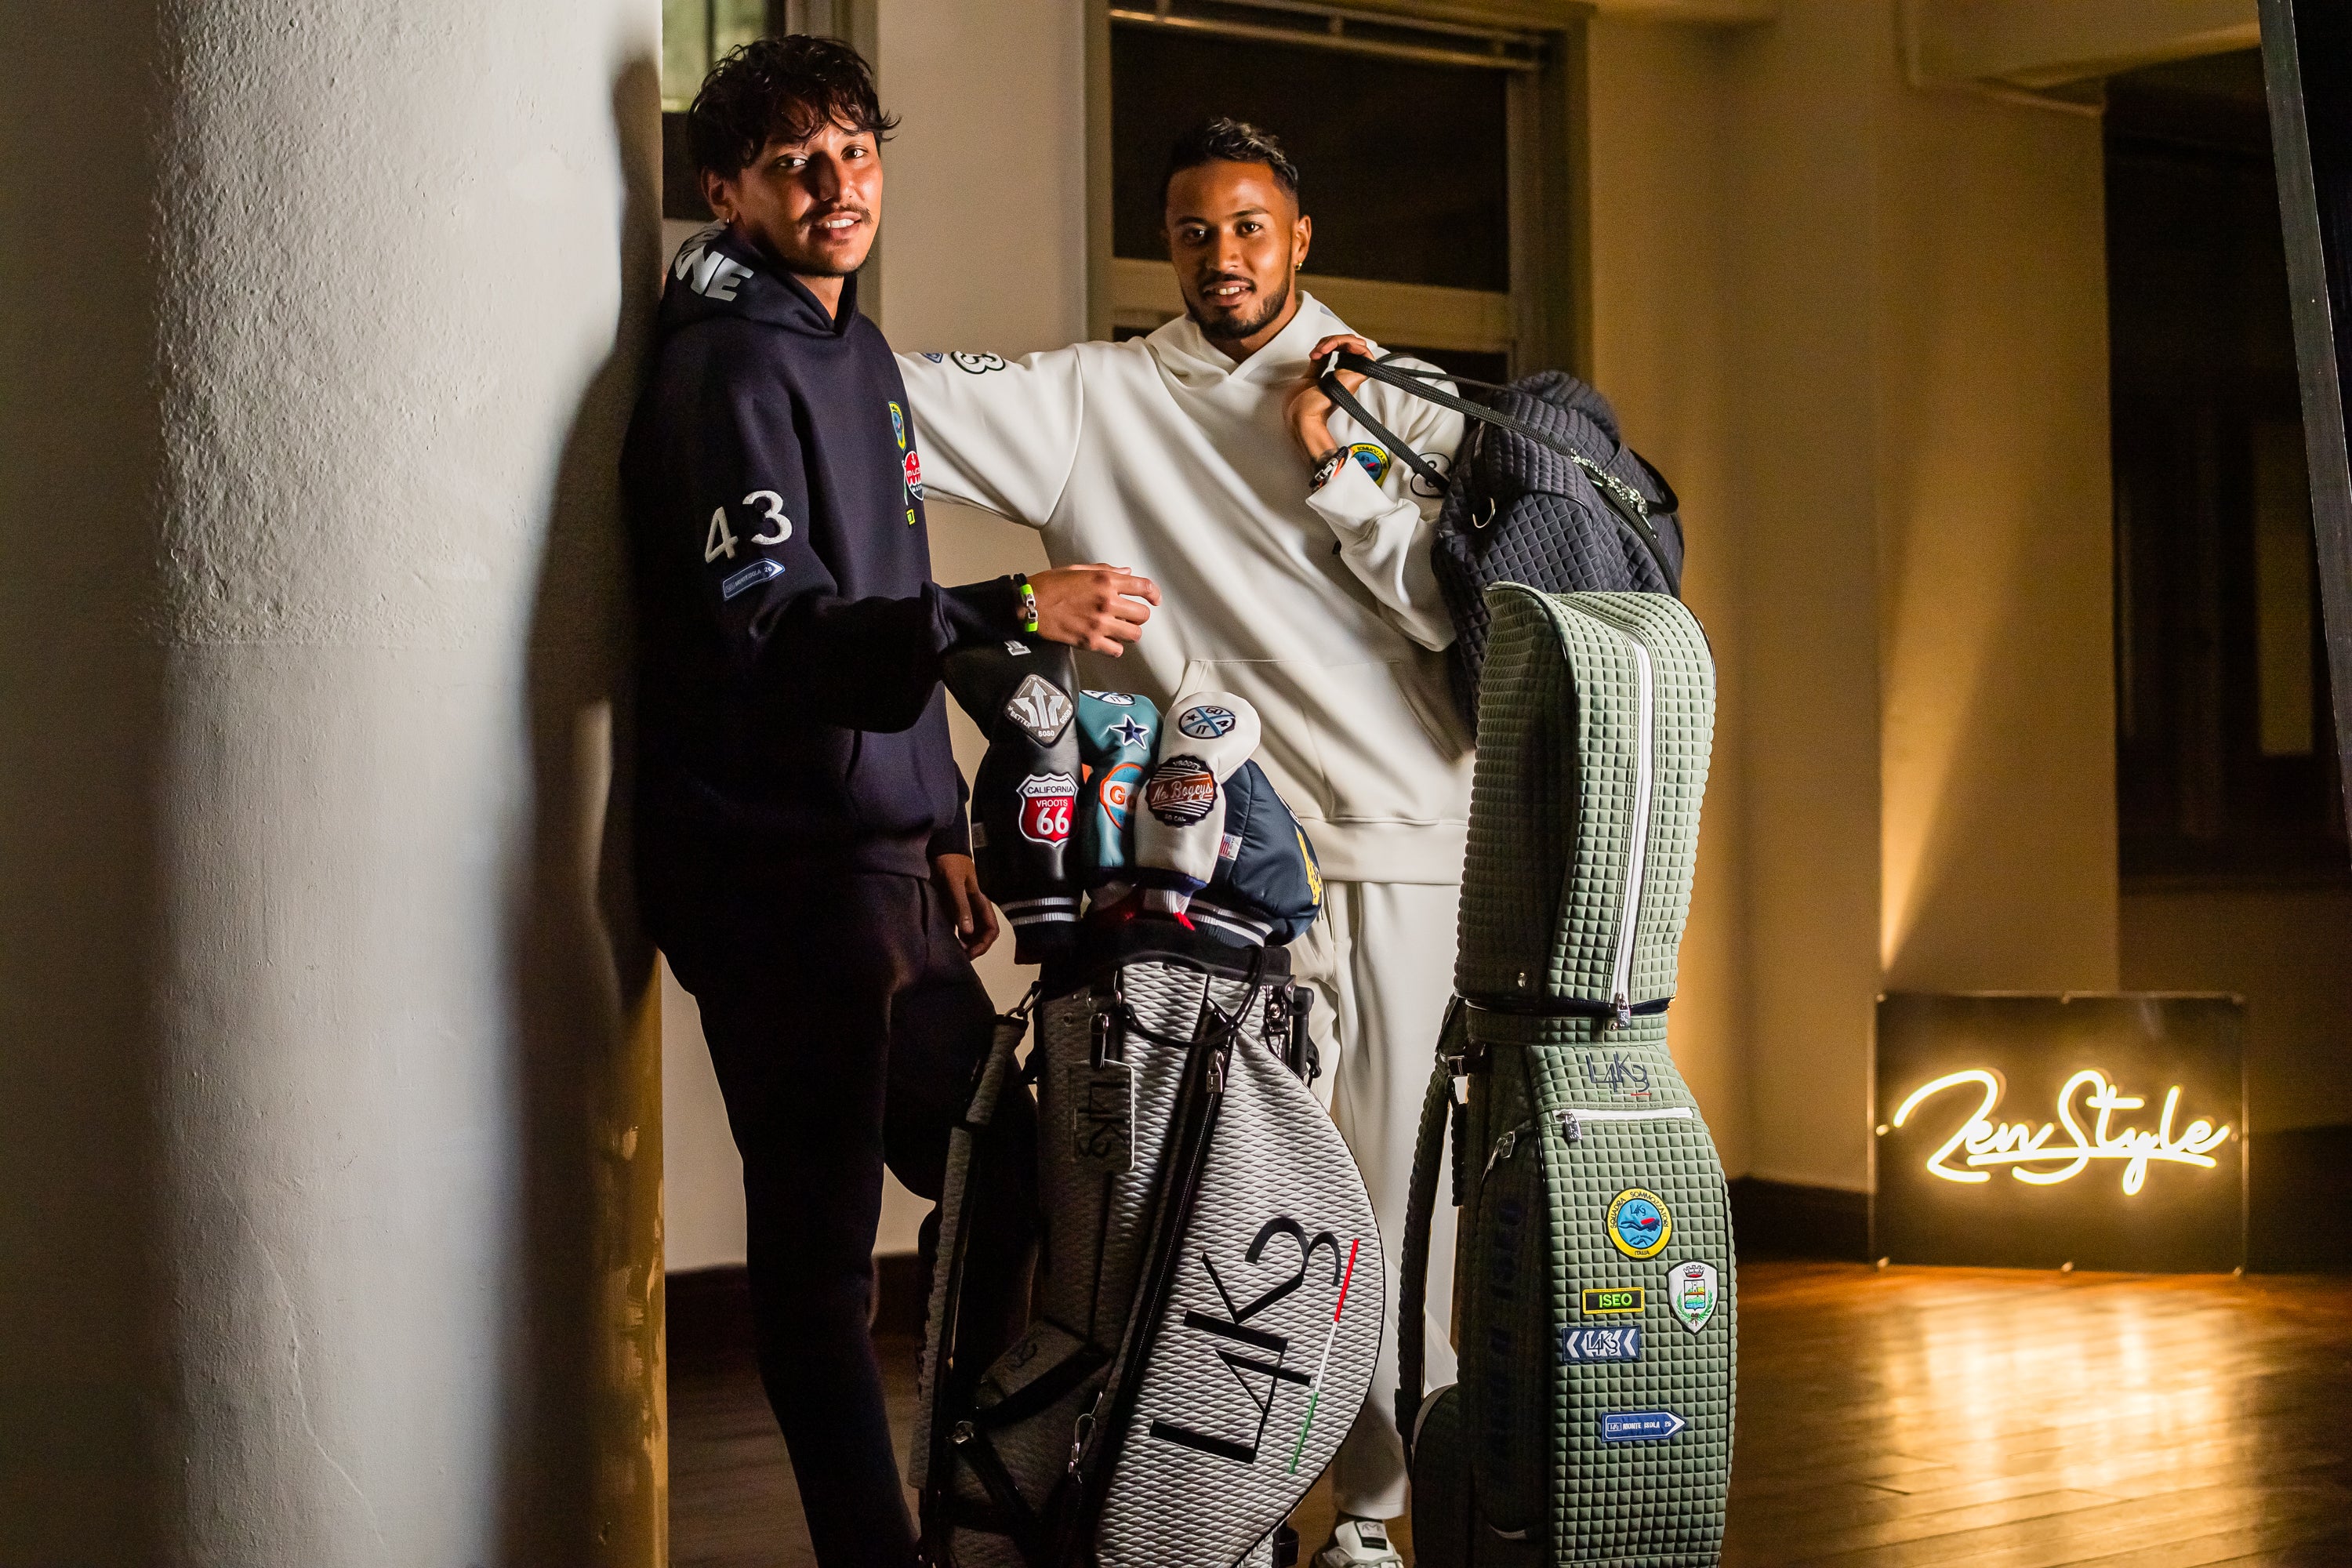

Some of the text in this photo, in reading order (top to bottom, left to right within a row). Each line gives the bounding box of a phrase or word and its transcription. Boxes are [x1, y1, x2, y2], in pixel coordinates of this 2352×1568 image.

[705, 490, 793, 564] 43
[1010, 711, 1032, 729] BETTER
[1059, 710, 1073, 724] GOOD
[1196, 725, 1209, 735] IT
[1170, 781, 1214, 800] Bogeys
[1036, 799, 1069, 808] VROOTS
[1036, 808, 1069, 835] 66
[1610, 1191, 1669, 1229] SQUADRA SOMMOZZATORI
[1599, 1293, 1633, 1308] ISEO
